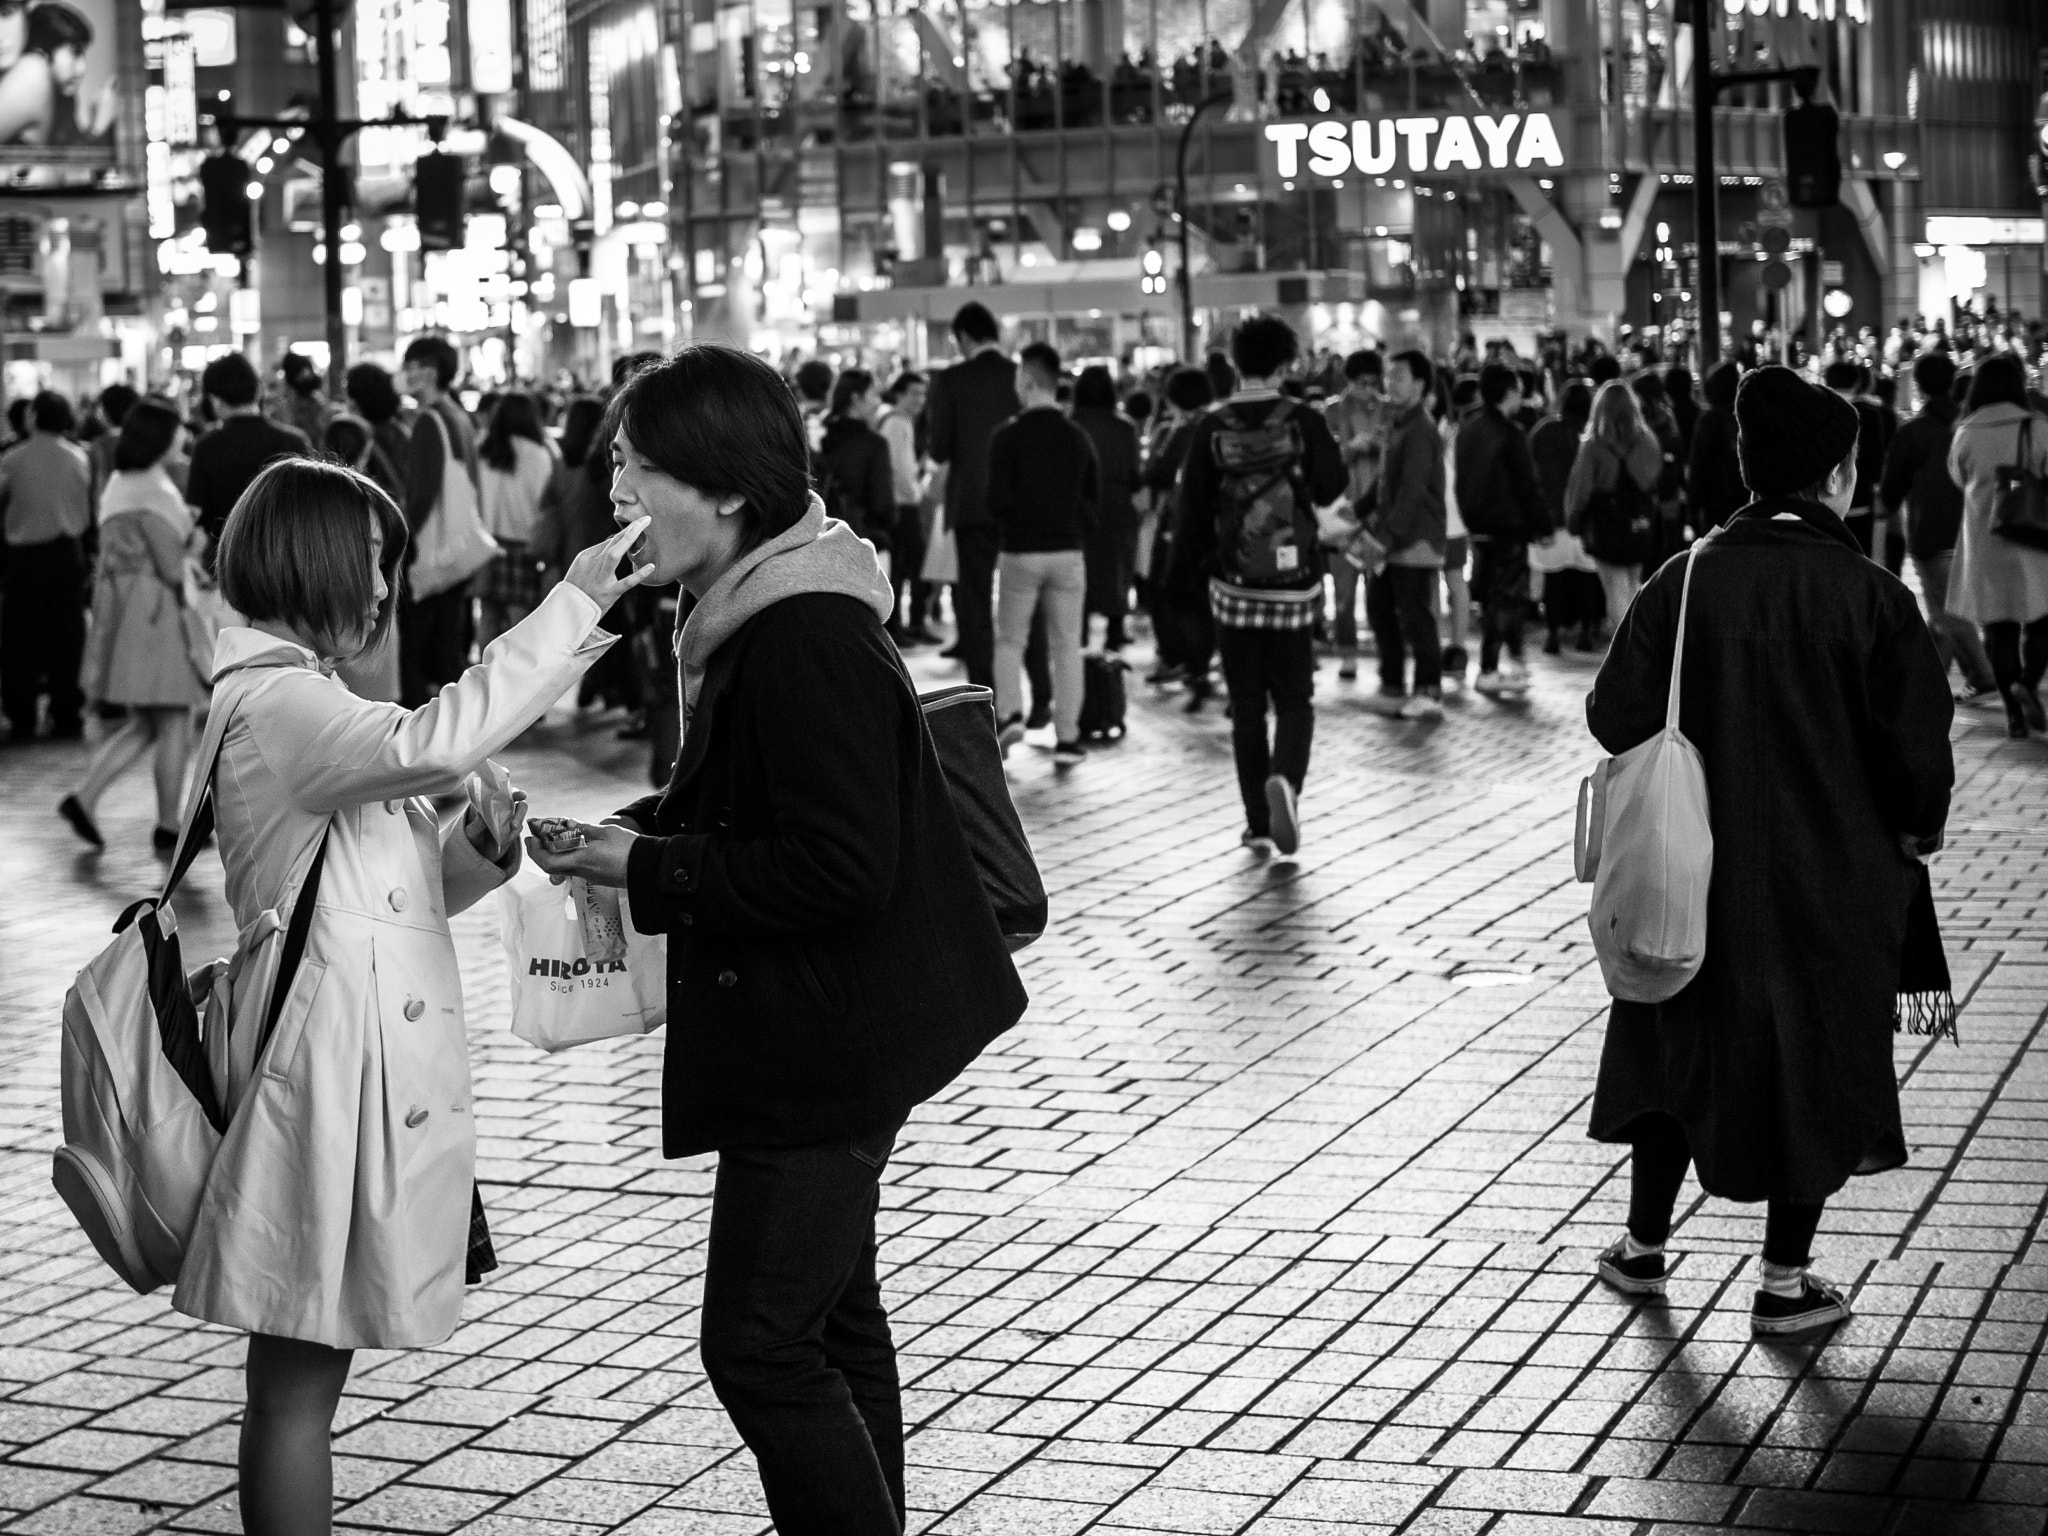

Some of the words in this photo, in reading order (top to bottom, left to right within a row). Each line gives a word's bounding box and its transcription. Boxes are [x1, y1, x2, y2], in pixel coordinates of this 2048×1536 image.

[1265, 113, 1564, 178] TSUTAYA
[529, 957, 627, 980] HIROTA
[550, 981, 574, 994] Sice
[581, 978, 609, 989] 1924
